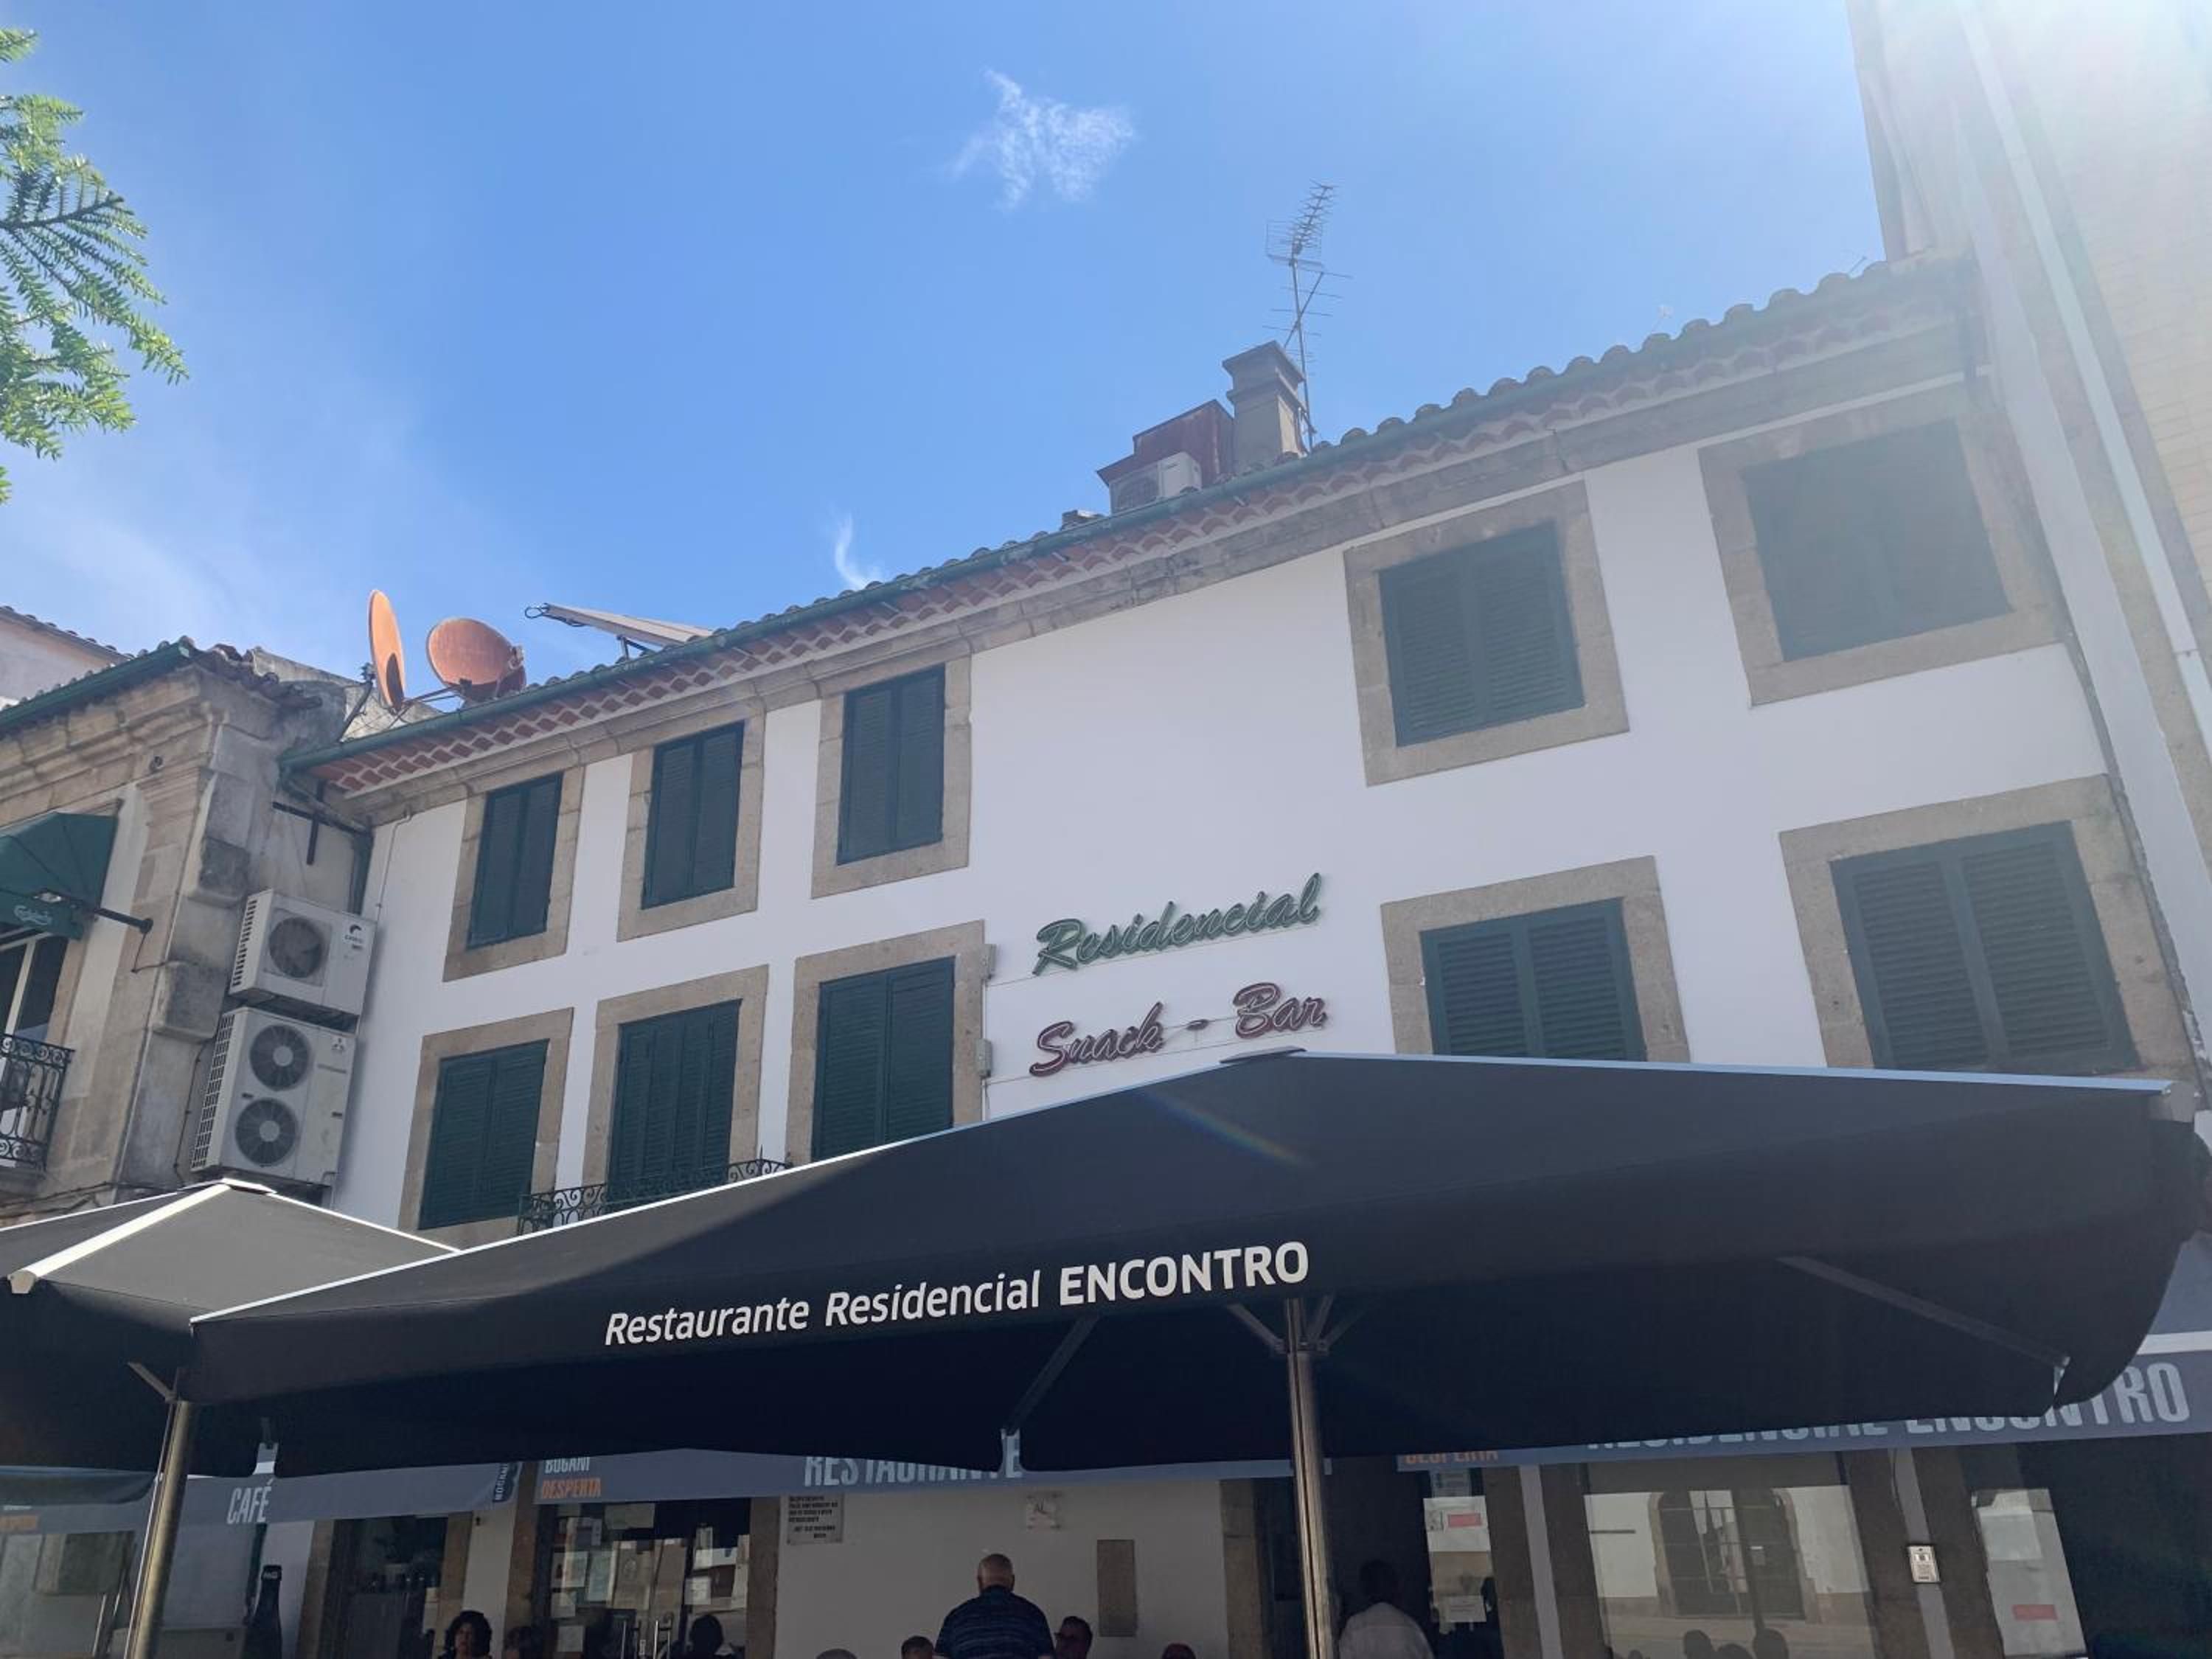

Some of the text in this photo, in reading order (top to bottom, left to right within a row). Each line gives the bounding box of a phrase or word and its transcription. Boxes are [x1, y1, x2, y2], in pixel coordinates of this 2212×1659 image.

[1032, 872, 1321, 977] Residencial
[1029, 1001, 1164, 1077] Snack
[1233, 982, 1328, 1040] Bar
[605, 1240, 1309, 1346] Restaurante Residencial ENCONTRO
[226, 1478, 274, 1524] CAFÉ
